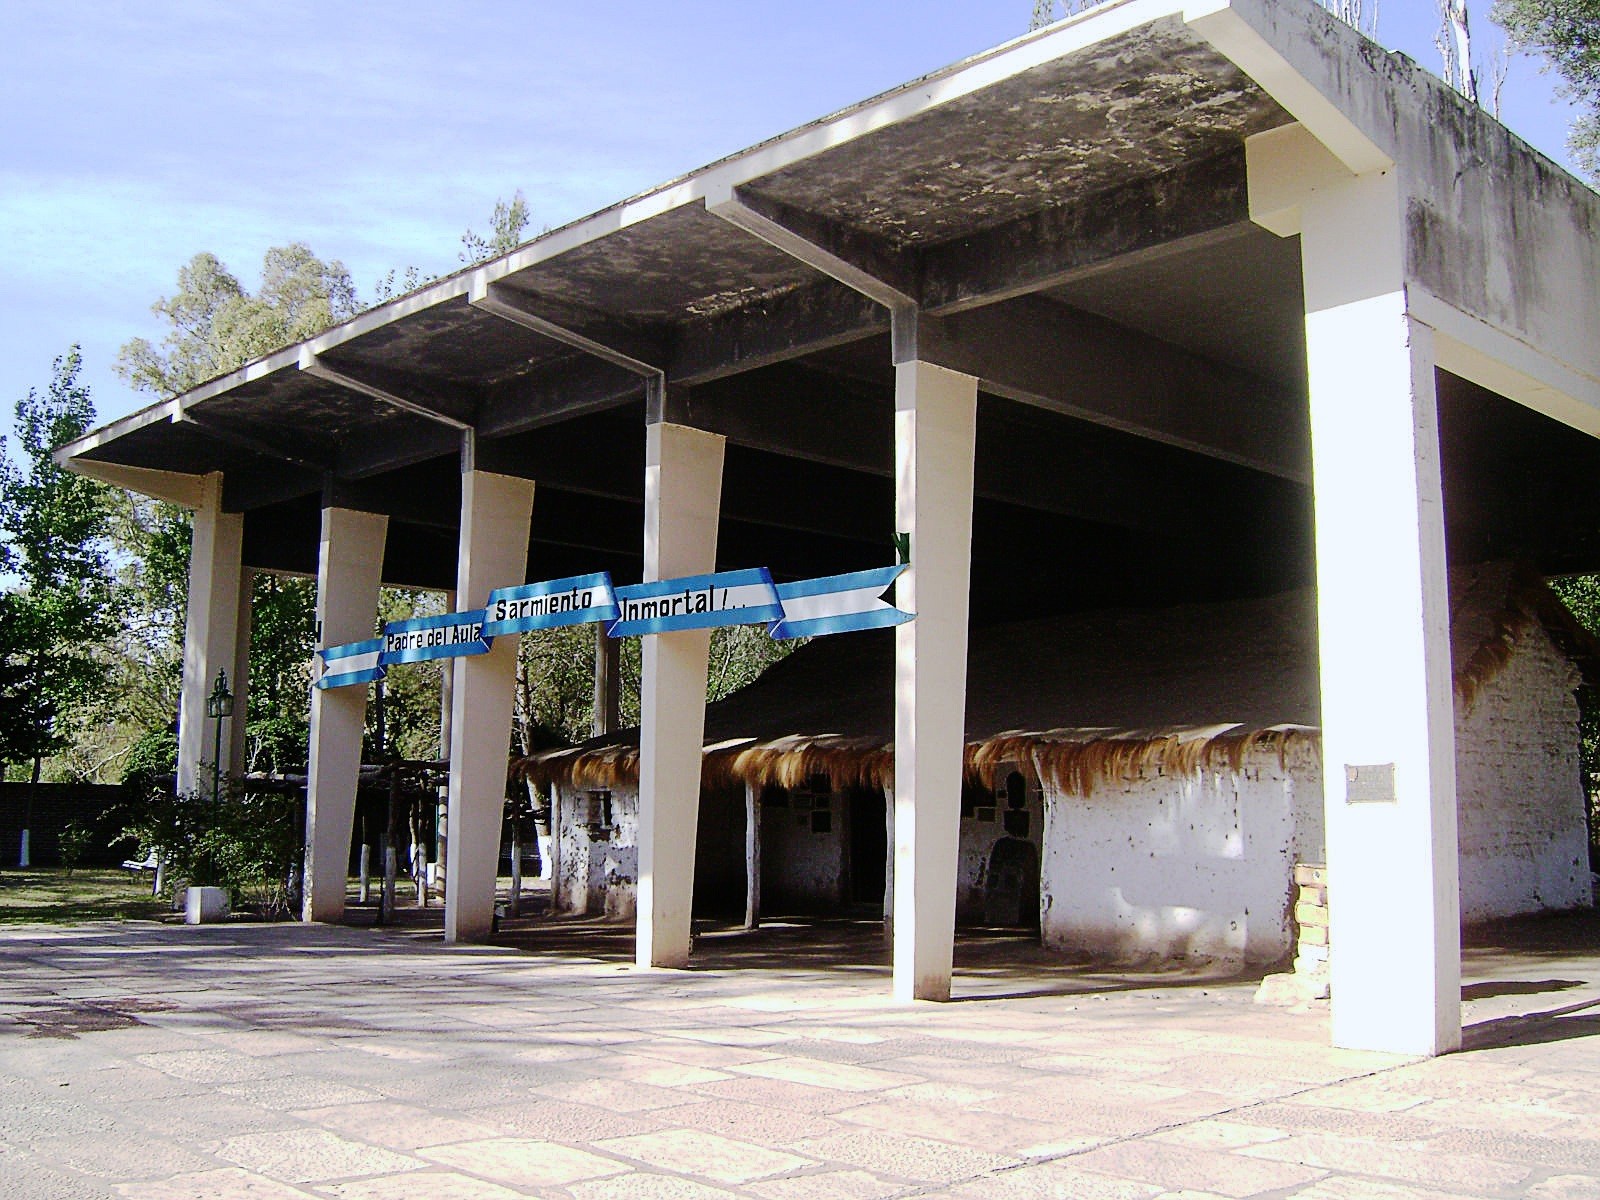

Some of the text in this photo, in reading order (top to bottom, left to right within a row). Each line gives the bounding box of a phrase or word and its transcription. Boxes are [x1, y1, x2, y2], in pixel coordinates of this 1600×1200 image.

[386, 632, 422, 653] Padre
[427, 627, 448, 648] del
[452, 623, 482, 645] Aula
[495, 586, 593, 622] Sarmiento
